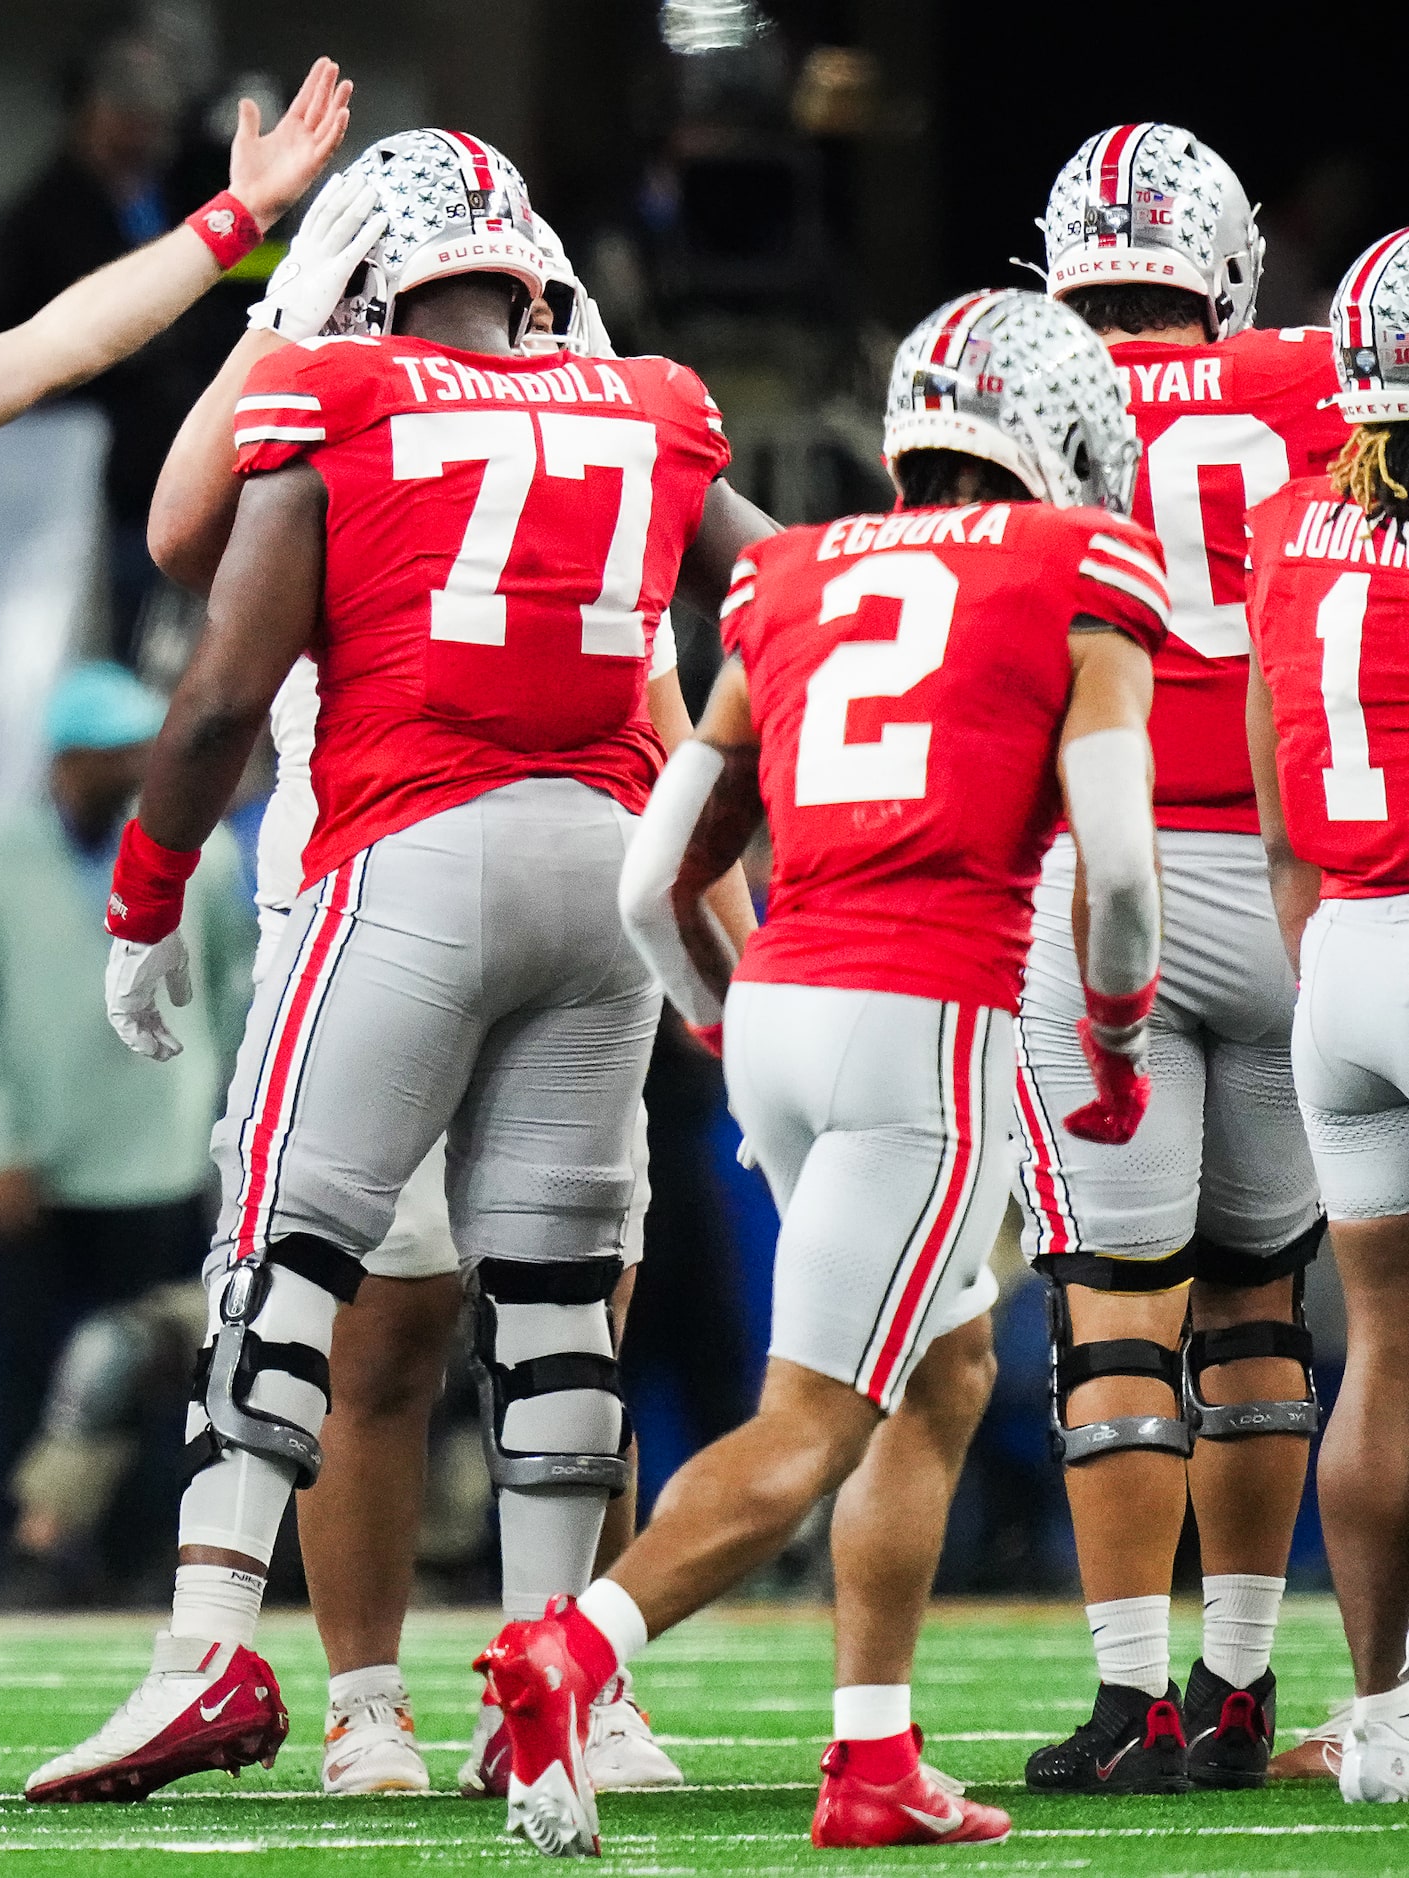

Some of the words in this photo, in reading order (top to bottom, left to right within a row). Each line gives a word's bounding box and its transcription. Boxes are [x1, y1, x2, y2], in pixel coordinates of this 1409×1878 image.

[392, 355, 633, 405] TSHABOLA
[1055, 260, 1175, 281] BUCKEYES
[390, 410, 658, 658] 77
[816, 502, 1012, 562] EGBUKA
[1126, 413, 1290, 659] 0
[795, 550, 960, 808] 2
[1316, 571, 1389, 822] 1
